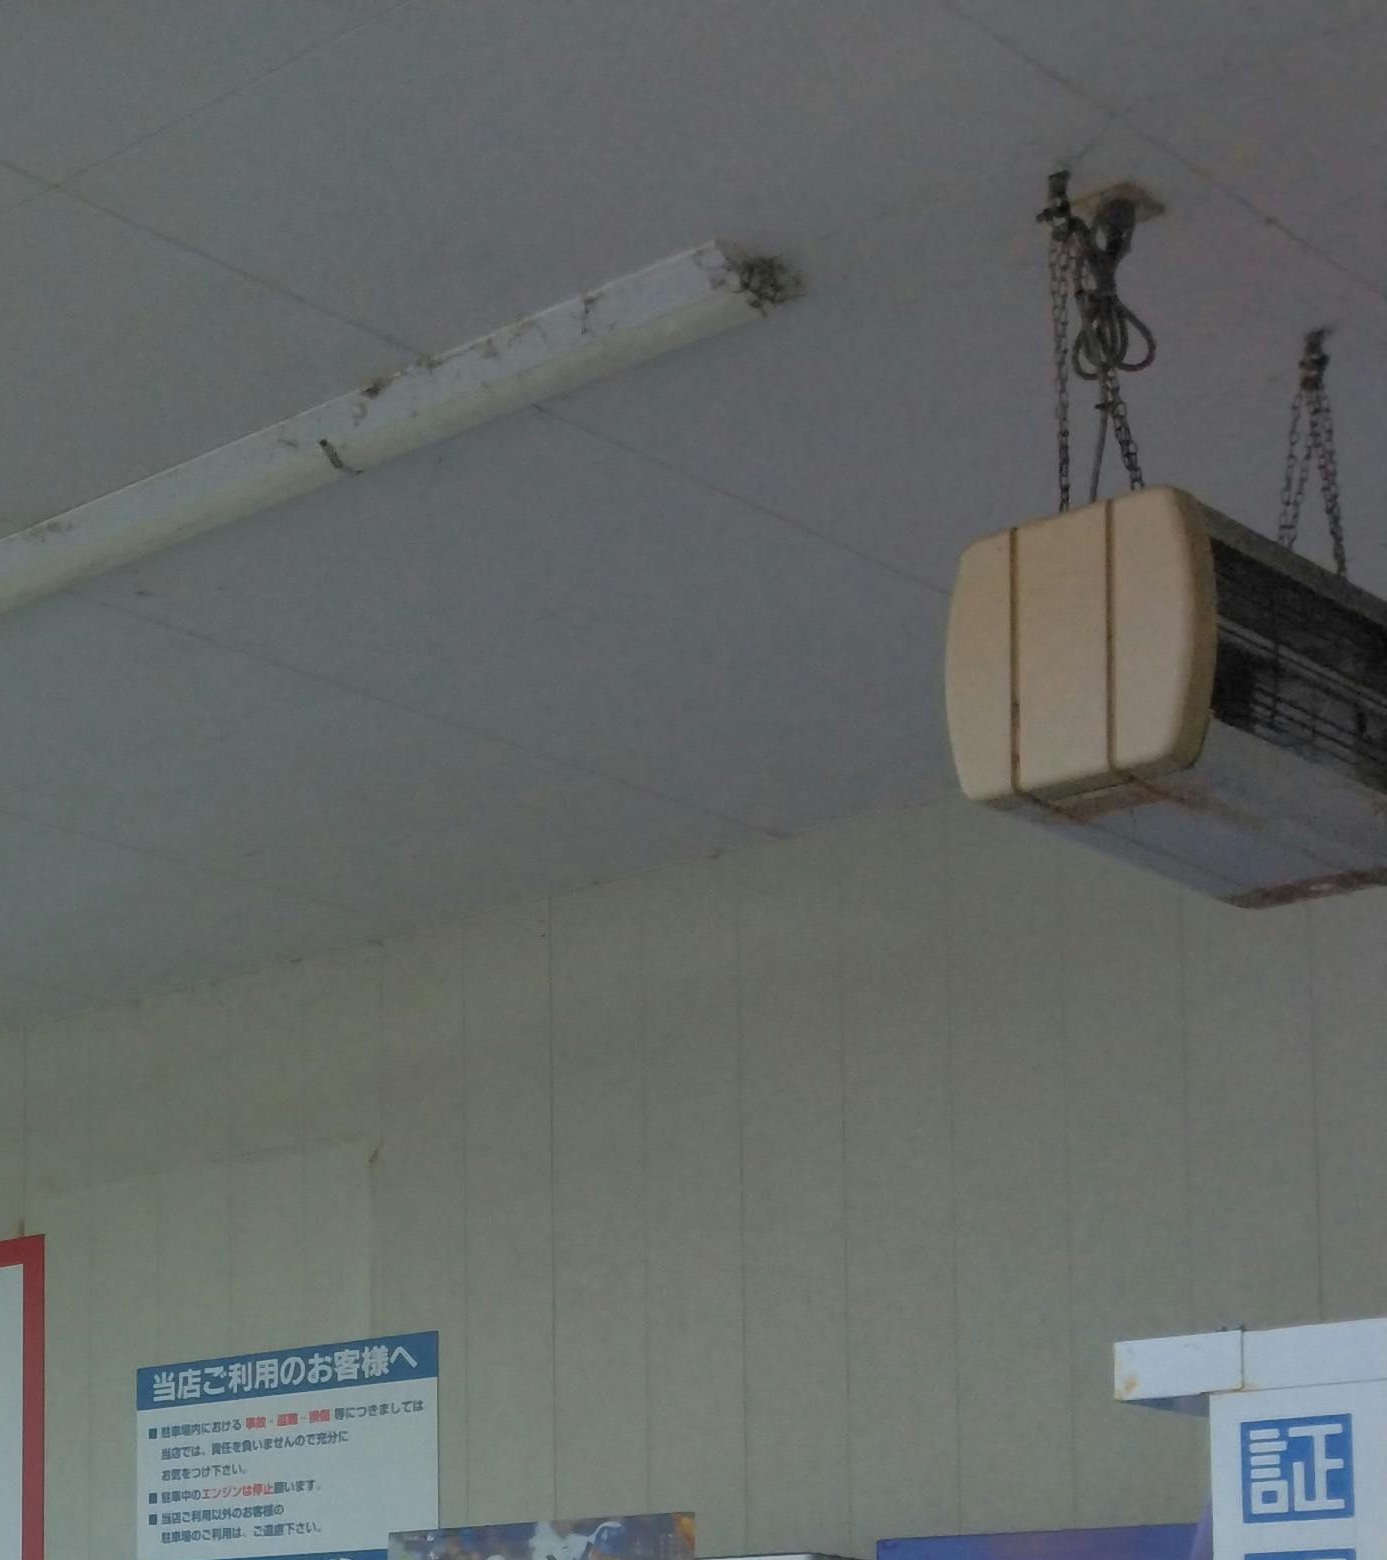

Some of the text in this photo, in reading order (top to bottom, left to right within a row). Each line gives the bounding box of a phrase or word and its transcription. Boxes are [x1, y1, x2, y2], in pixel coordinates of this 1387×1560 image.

[152, 1345, 418, 1402] 当店ご利用のお客様へ
